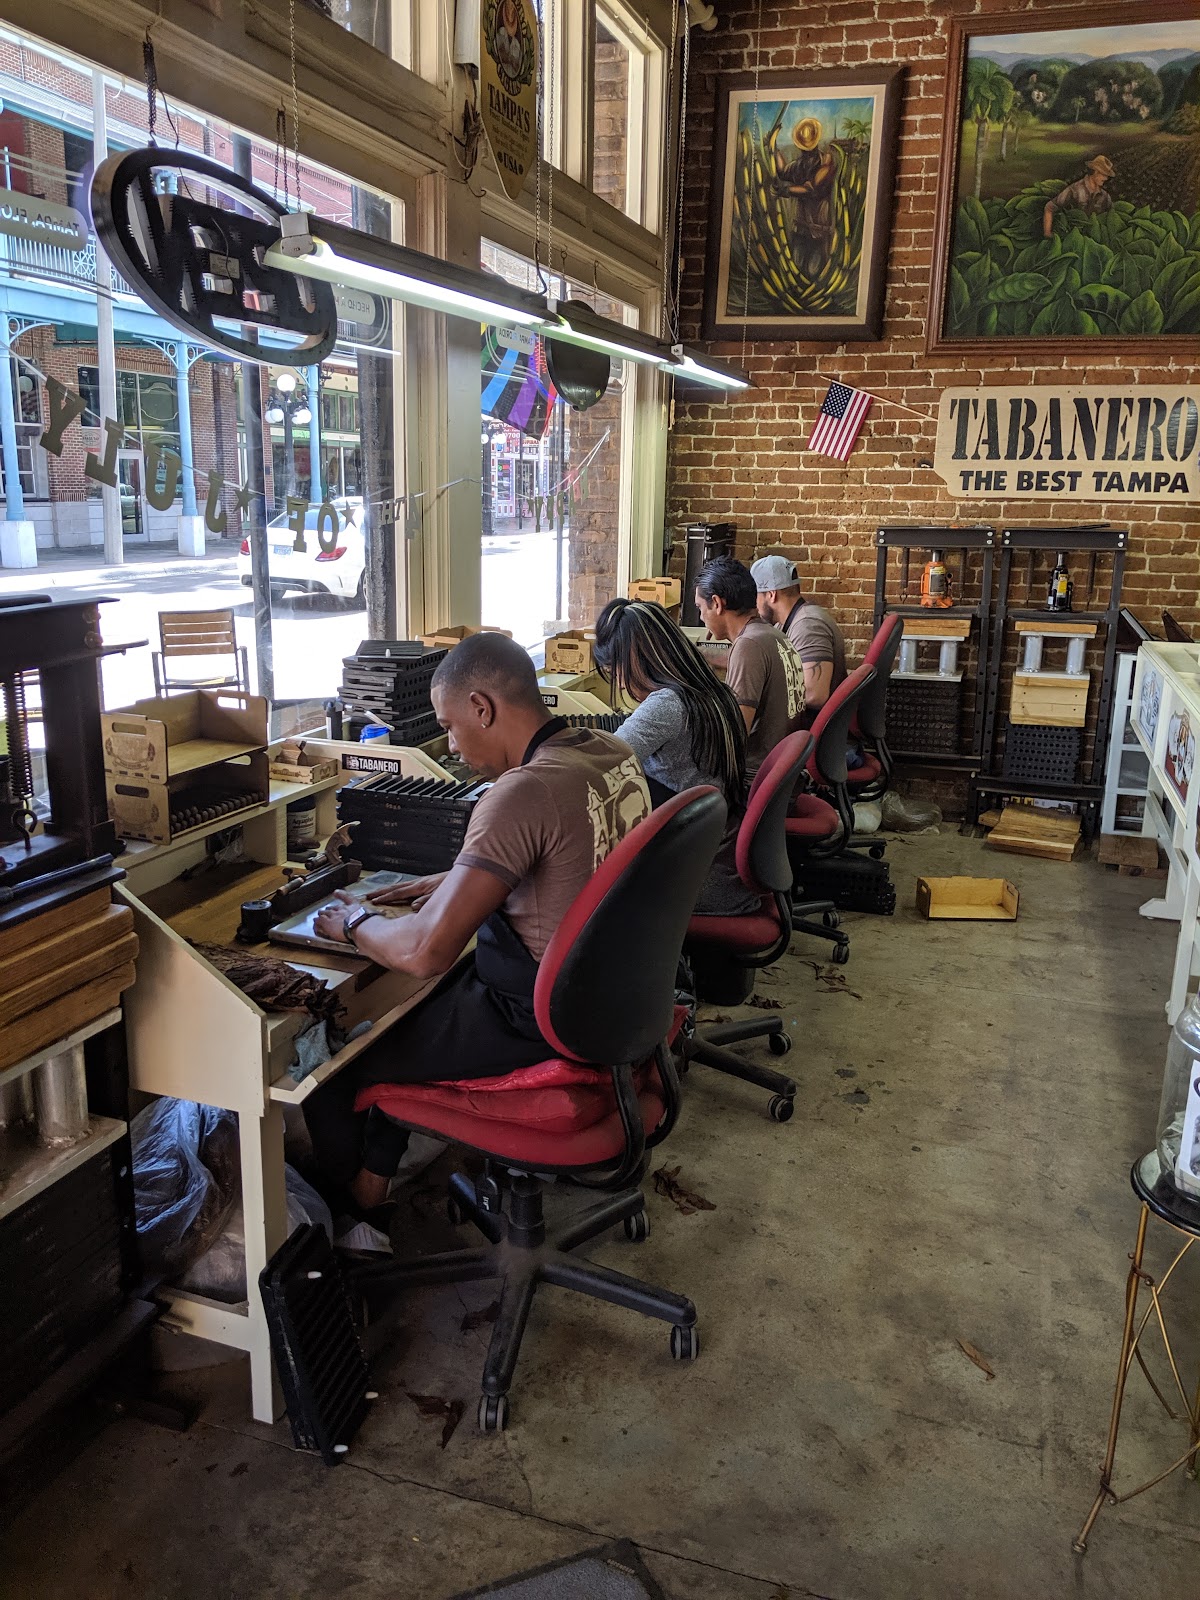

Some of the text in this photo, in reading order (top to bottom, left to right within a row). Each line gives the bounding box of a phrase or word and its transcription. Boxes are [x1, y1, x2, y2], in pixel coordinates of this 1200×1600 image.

[488, 82, 530, 133] TAMPA'S
[503, 151, 518, 176] USA
[950, 396, 1199, 462] TABANERO
[959, 470, 1190, 493] THE BEST TAMPA
[359, 757, 399, 773] TABANERO
[602, 754, 641, 796] BEST
